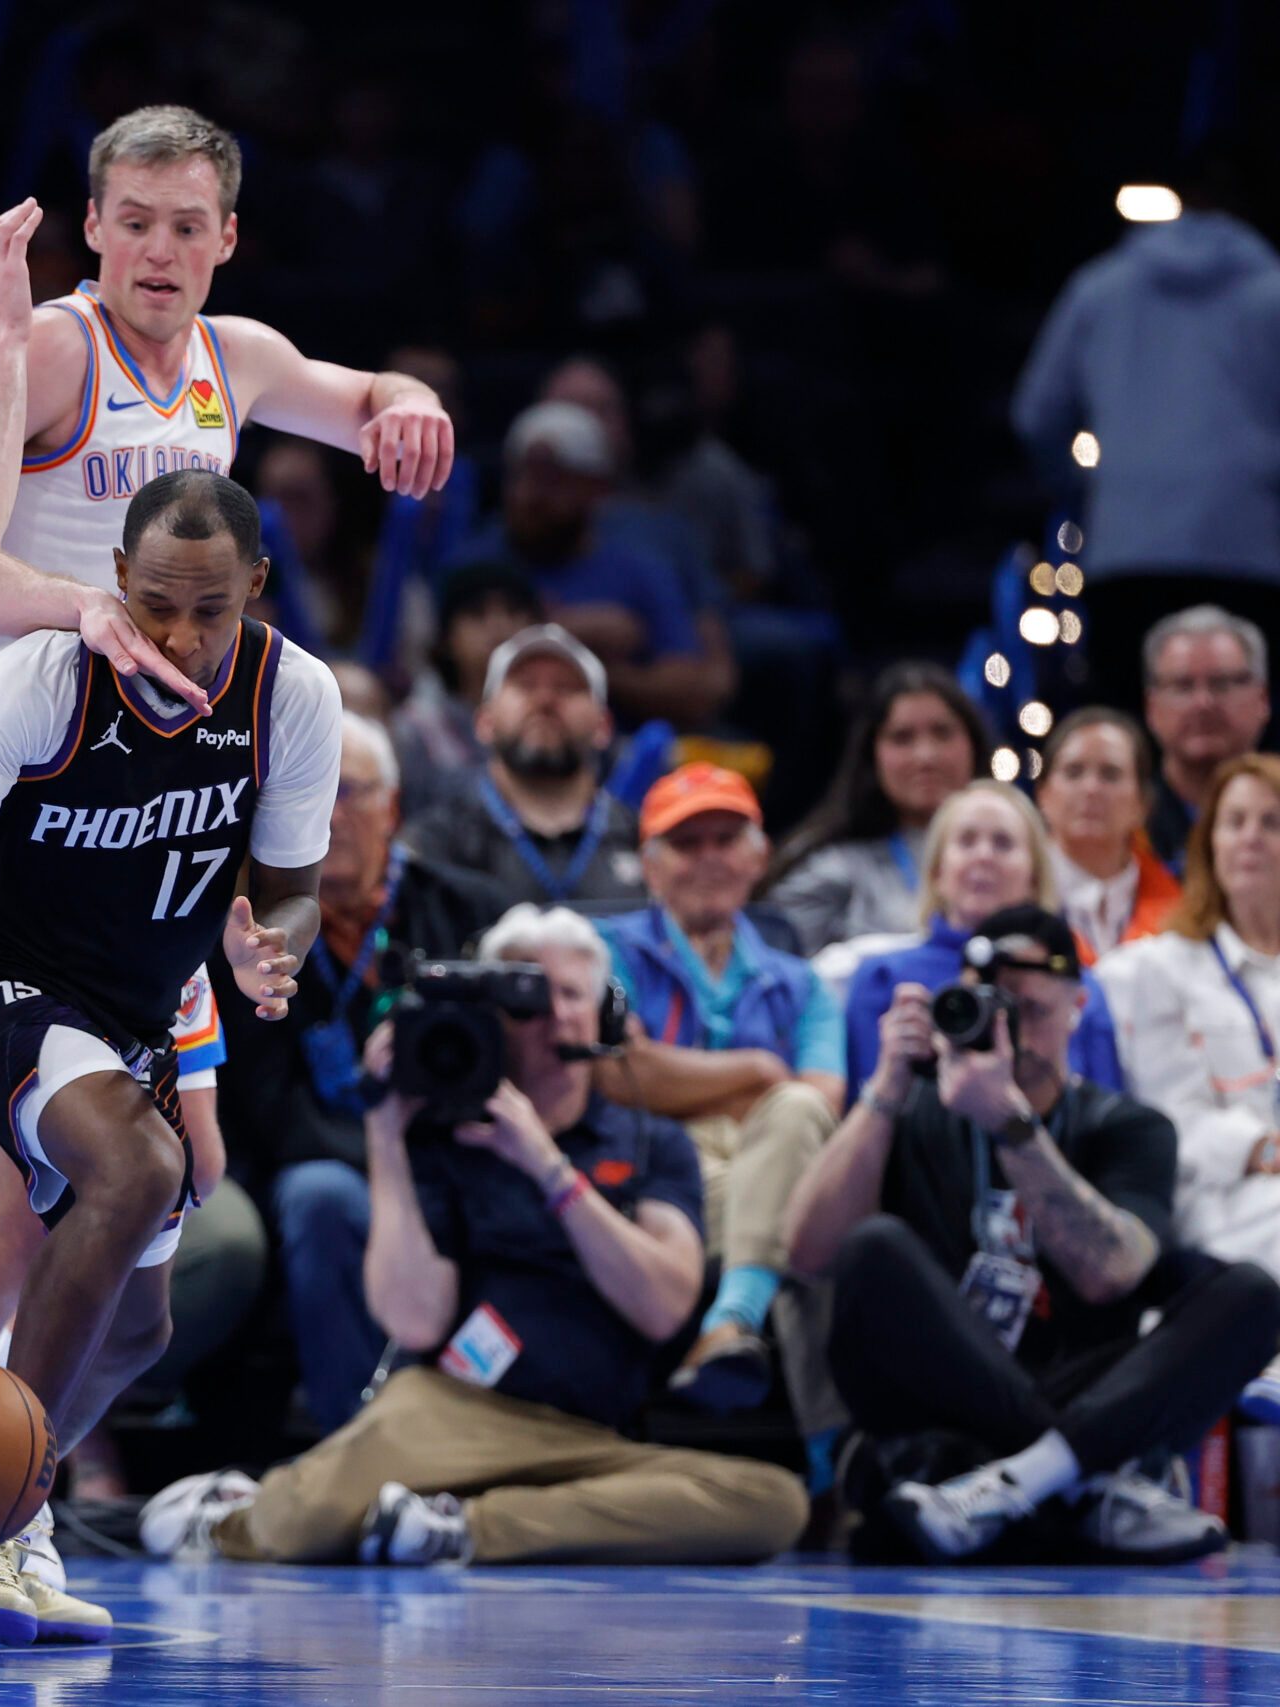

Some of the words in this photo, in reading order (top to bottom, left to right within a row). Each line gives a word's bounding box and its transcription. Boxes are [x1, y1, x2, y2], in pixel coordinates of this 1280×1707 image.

[195, 727, 251, 750] PayPal
[30, 776, 251, 850] PHOENIX
[151, 846, 231, 921] 17
